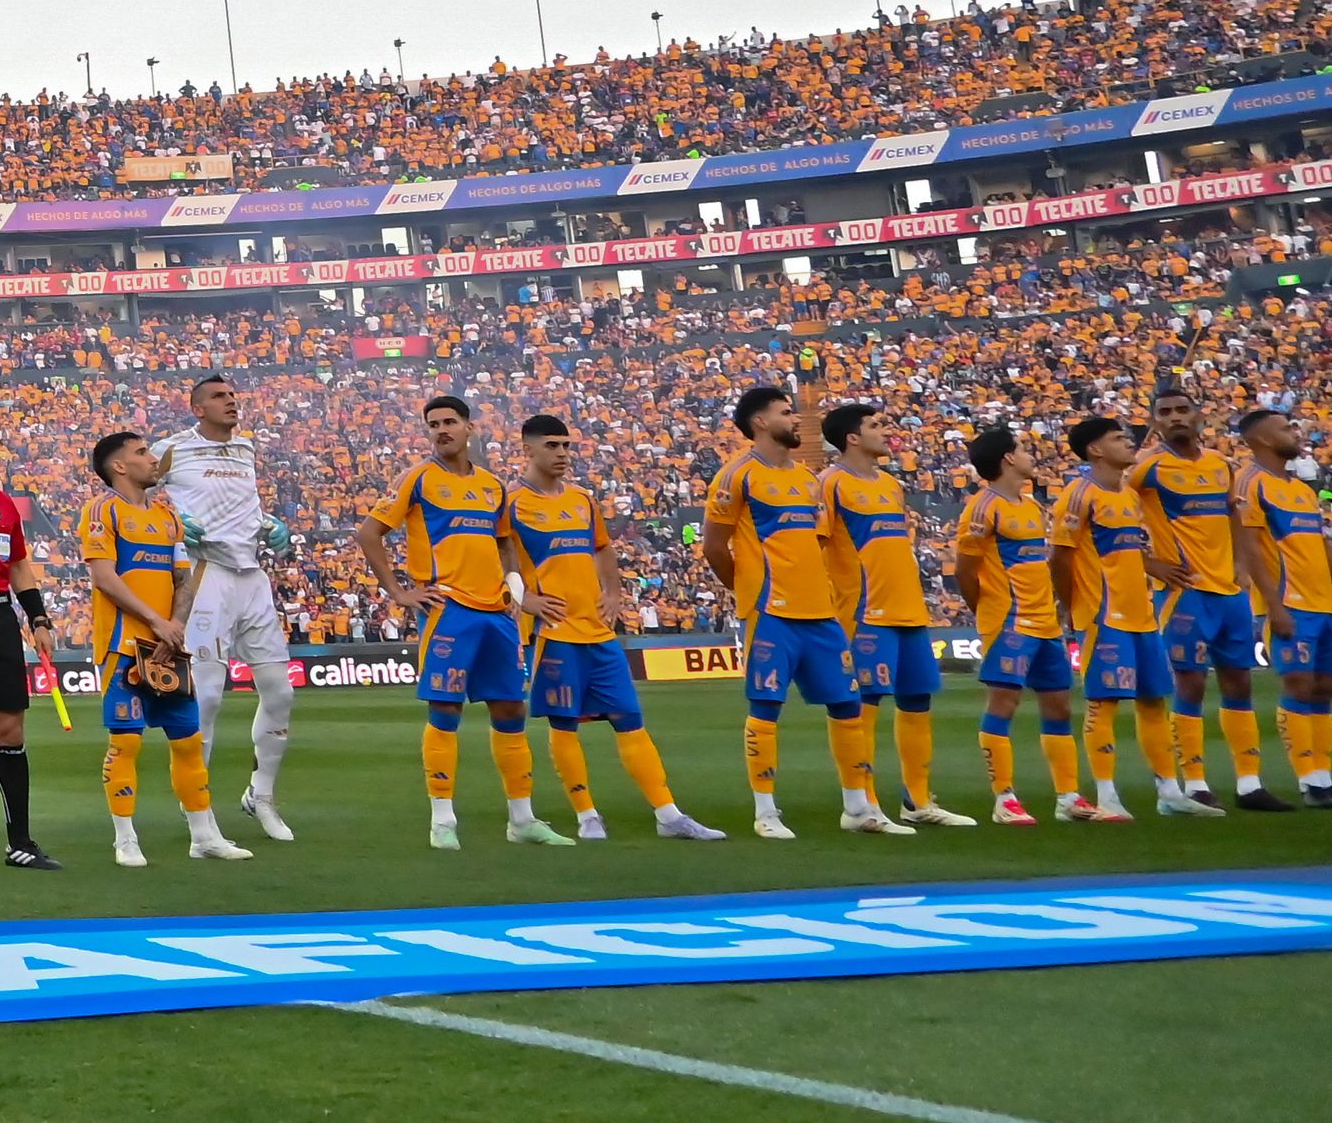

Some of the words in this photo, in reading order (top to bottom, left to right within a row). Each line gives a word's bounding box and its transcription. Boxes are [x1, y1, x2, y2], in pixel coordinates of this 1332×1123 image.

[27, 211, 70, 221] HECHOS
[74, 210, 88, 220] DE
[91, 210, 121, 220] ALGO
[185, 206, 226, 217] CEMEX
[240, 203, 285, 214] HECHOS
[288, 202, 303, 212] DE
[311, 200, 341, 211] ALGO
[401, 192, 444, 204] CEMEX
[469, 187, 516, 198] HECHOS
[519, 184, 536, 195] DE
[539, 182, 571, 194] ALGO
[643, 171, 689, 185] CEMEX
[706, 166, 755, 178] HECHOS
[759, 162, 777, 173] DE
[785, 158, 819, 170] ALGO
[886, 144, 935, 159] CEMEX
[962, 134, 1017, 150] HECHOS
[1021, 129, 1039, 142] DE
[1161, 105, 1215, 122] CEMEX
[1233, 94, 1293, 110] HECHOS
[1297, 89, 1316, 102] DE
[113, 272, 169, 292] TECATE
[231, 266, 289, 285] TECATE
[355, 259, 415, 278] TECATE
[481, 250, 543, 271] TECATE
[611, 240, 676, 261] TECATE
[747, 227, 815, 250] TECATE
[888, 214, 958, 237] TECATE
[1035, 194, 1106, 220] TECATE
[1188, 173, 1264, 201] TECATE
[1195, 641, 1207, 664] 2
[1297, 642, 1309, 664] 5
[754, 669, 778, 692] 14
[876, 663, 890, 686] 9
